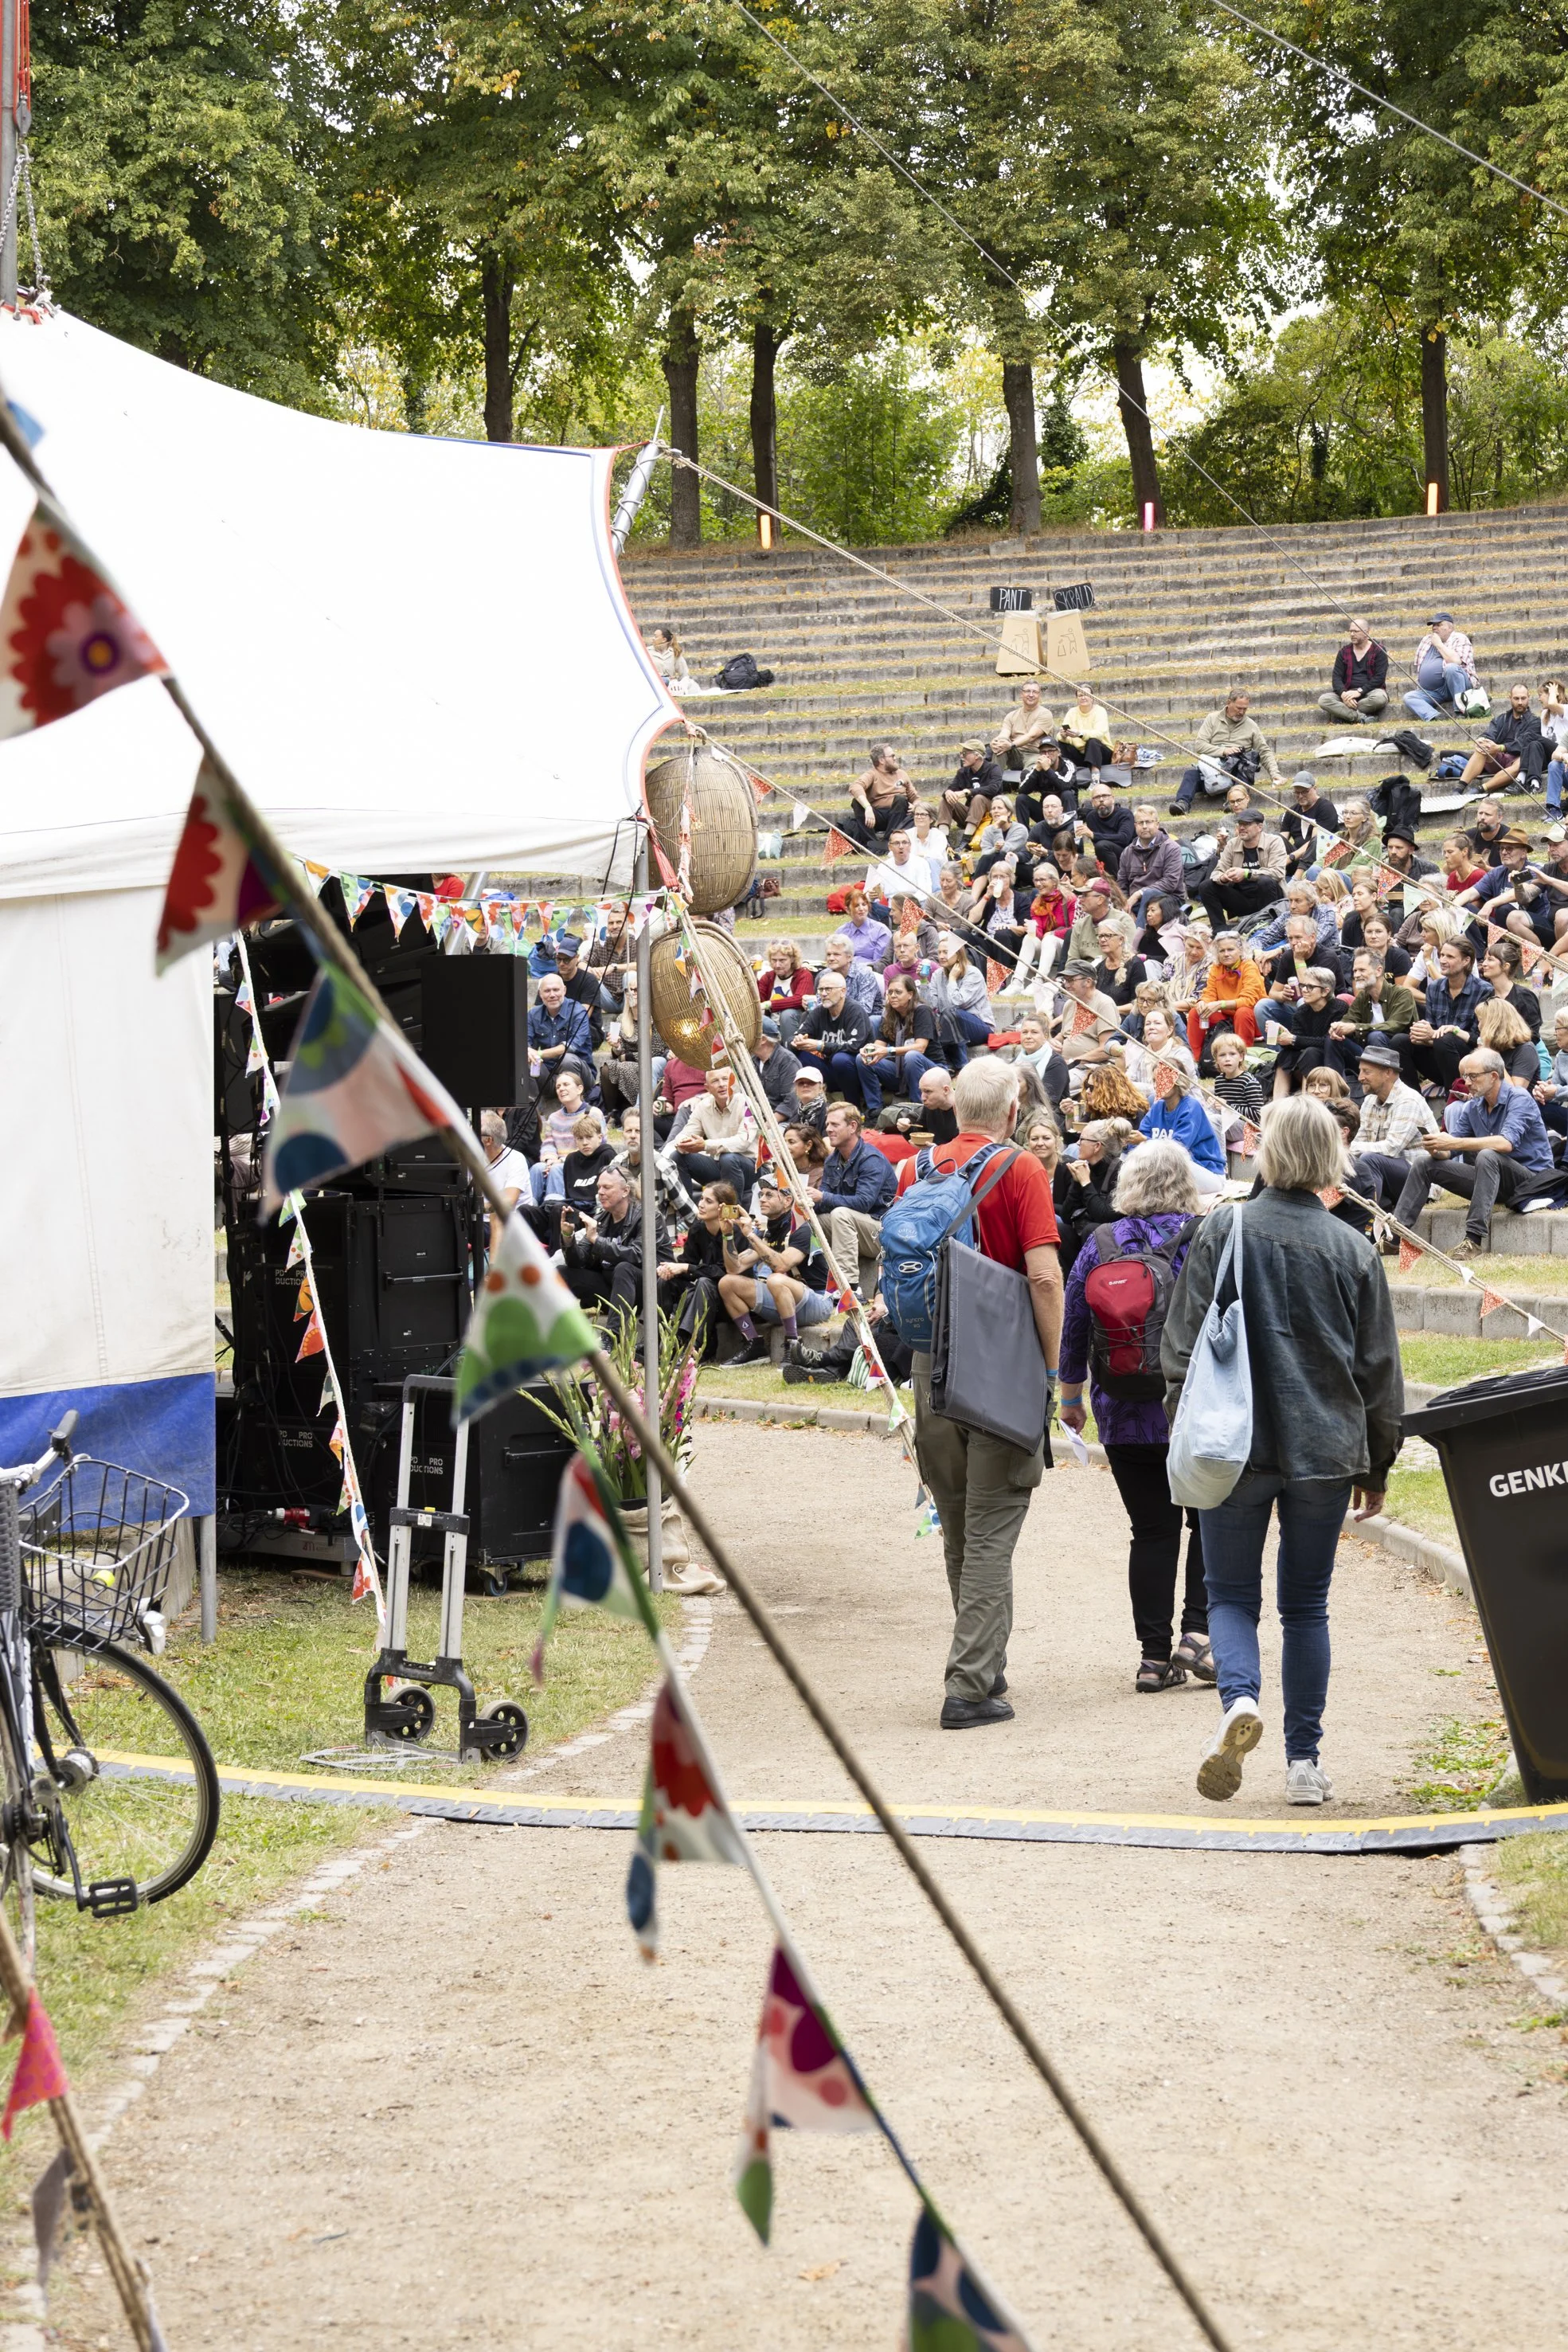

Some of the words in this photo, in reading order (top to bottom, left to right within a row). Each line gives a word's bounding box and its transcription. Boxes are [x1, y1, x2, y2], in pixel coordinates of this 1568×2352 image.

[999, 588, 1027, 611] PANT
[1054, 585, 1093, 611] SKRALD
[298, 1430, 313, 1439] PRO
[278, 1438, 313, 1448] UCTIONS
[428, 1457, 444, 1466] PRO
